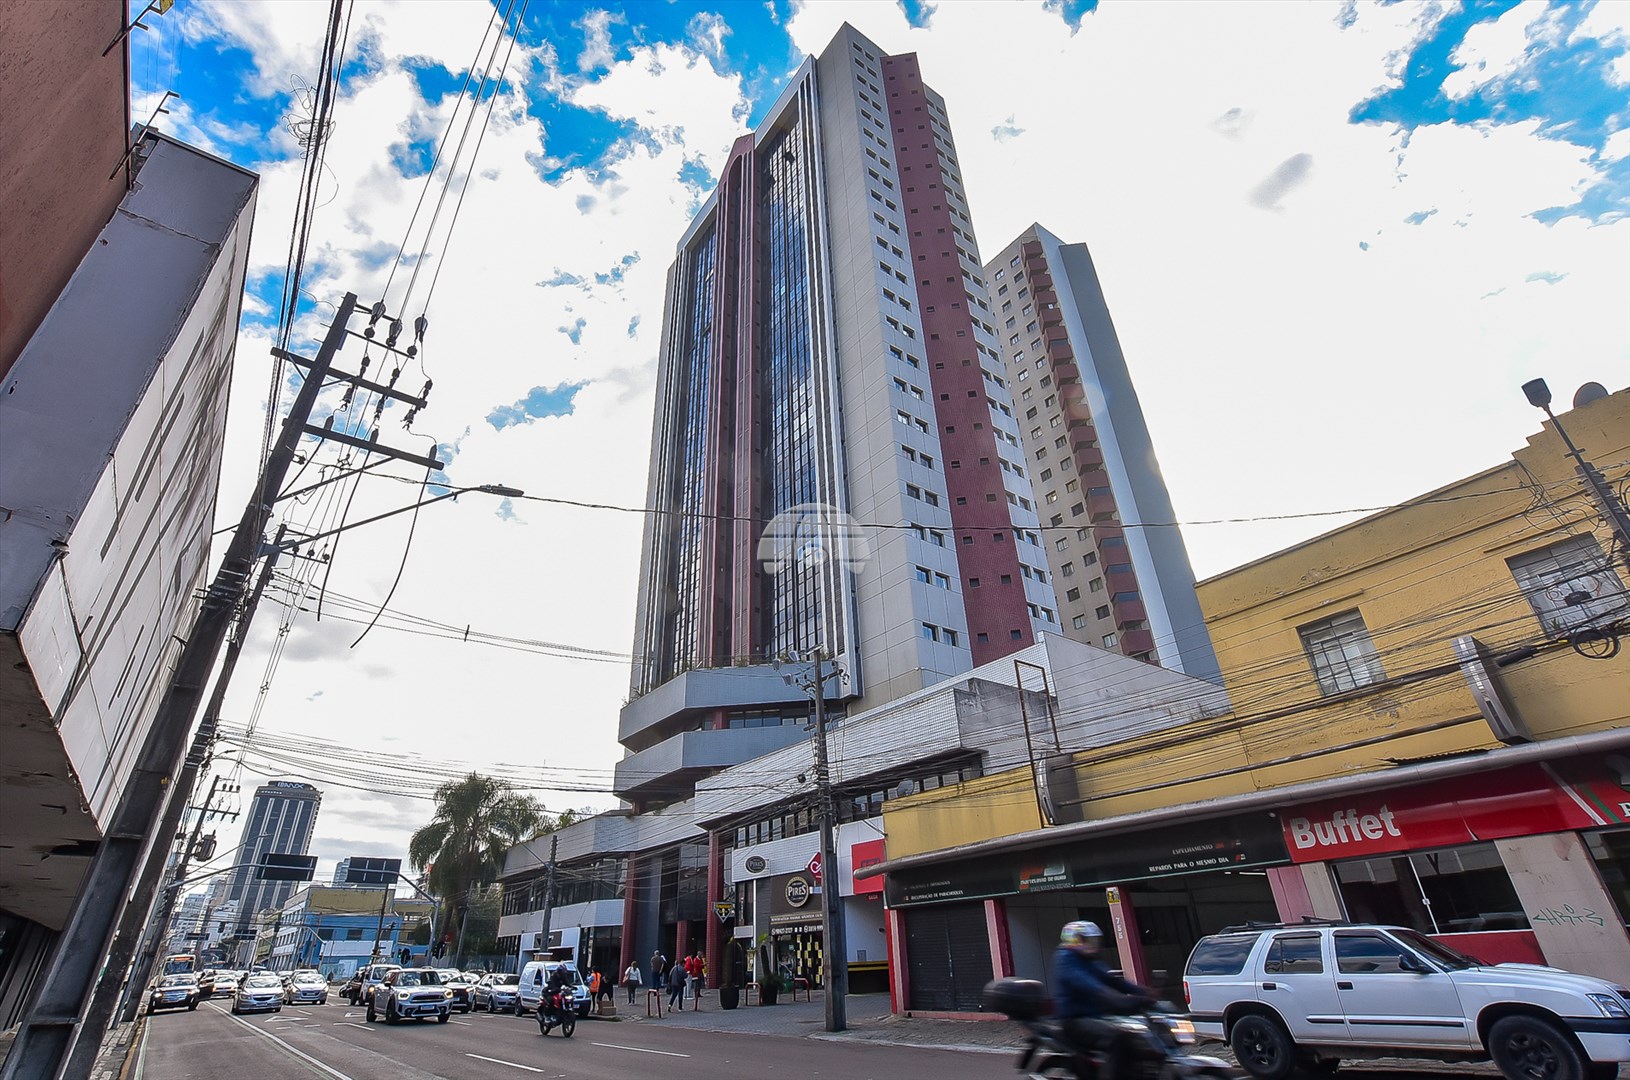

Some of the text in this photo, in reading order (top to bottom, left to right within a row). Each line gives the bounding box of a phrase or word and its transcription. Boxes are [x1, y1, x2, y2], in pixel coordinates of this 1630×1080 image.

[1290, 804, 1401, 849] Buffet
[1149, 863, 1173, 872] REPAROS
[1174, 862, 1188, 870] PARA
[1196, 858, 1217, 867] MESMO
[787, 884, 807, 897] PIRES
[1115, 917, 1124, 940] 755
